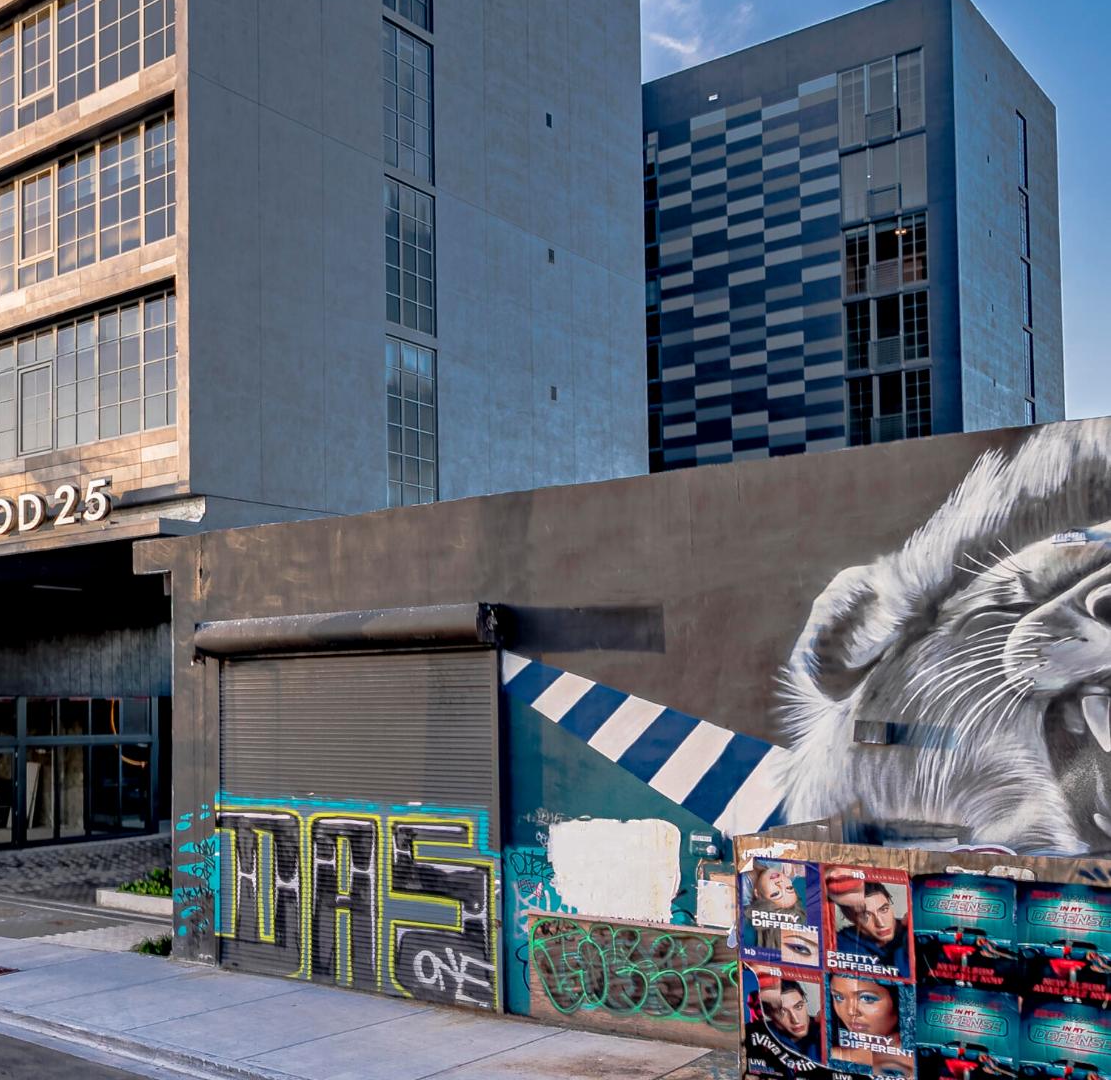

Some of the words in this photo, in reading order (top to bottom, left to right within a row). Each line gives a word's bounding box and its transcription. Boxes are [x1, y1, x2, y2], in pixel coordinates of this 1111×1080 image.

[55, 478, 111, 526] 25
[924, 899, 1001, 915] DEFENSE
[751, 910, 800, 923] PRETTY
[752, 918, 819, 933] DIFFERENT
[827, 950, 879, 965] PRETTY
[827, 959, 900, 977] DIFFERENT
[980, 974, 1004, 986] NOW
[930, 1013, 1003, 1032] DEFENSE
[840, 1029, 893, 1046] PRETTY
[840, 1039, 914, 1058] DIFFERENT
[750, 1058, 767, 1067] LIVE
[780, 1052, 816, 1071] Latin
